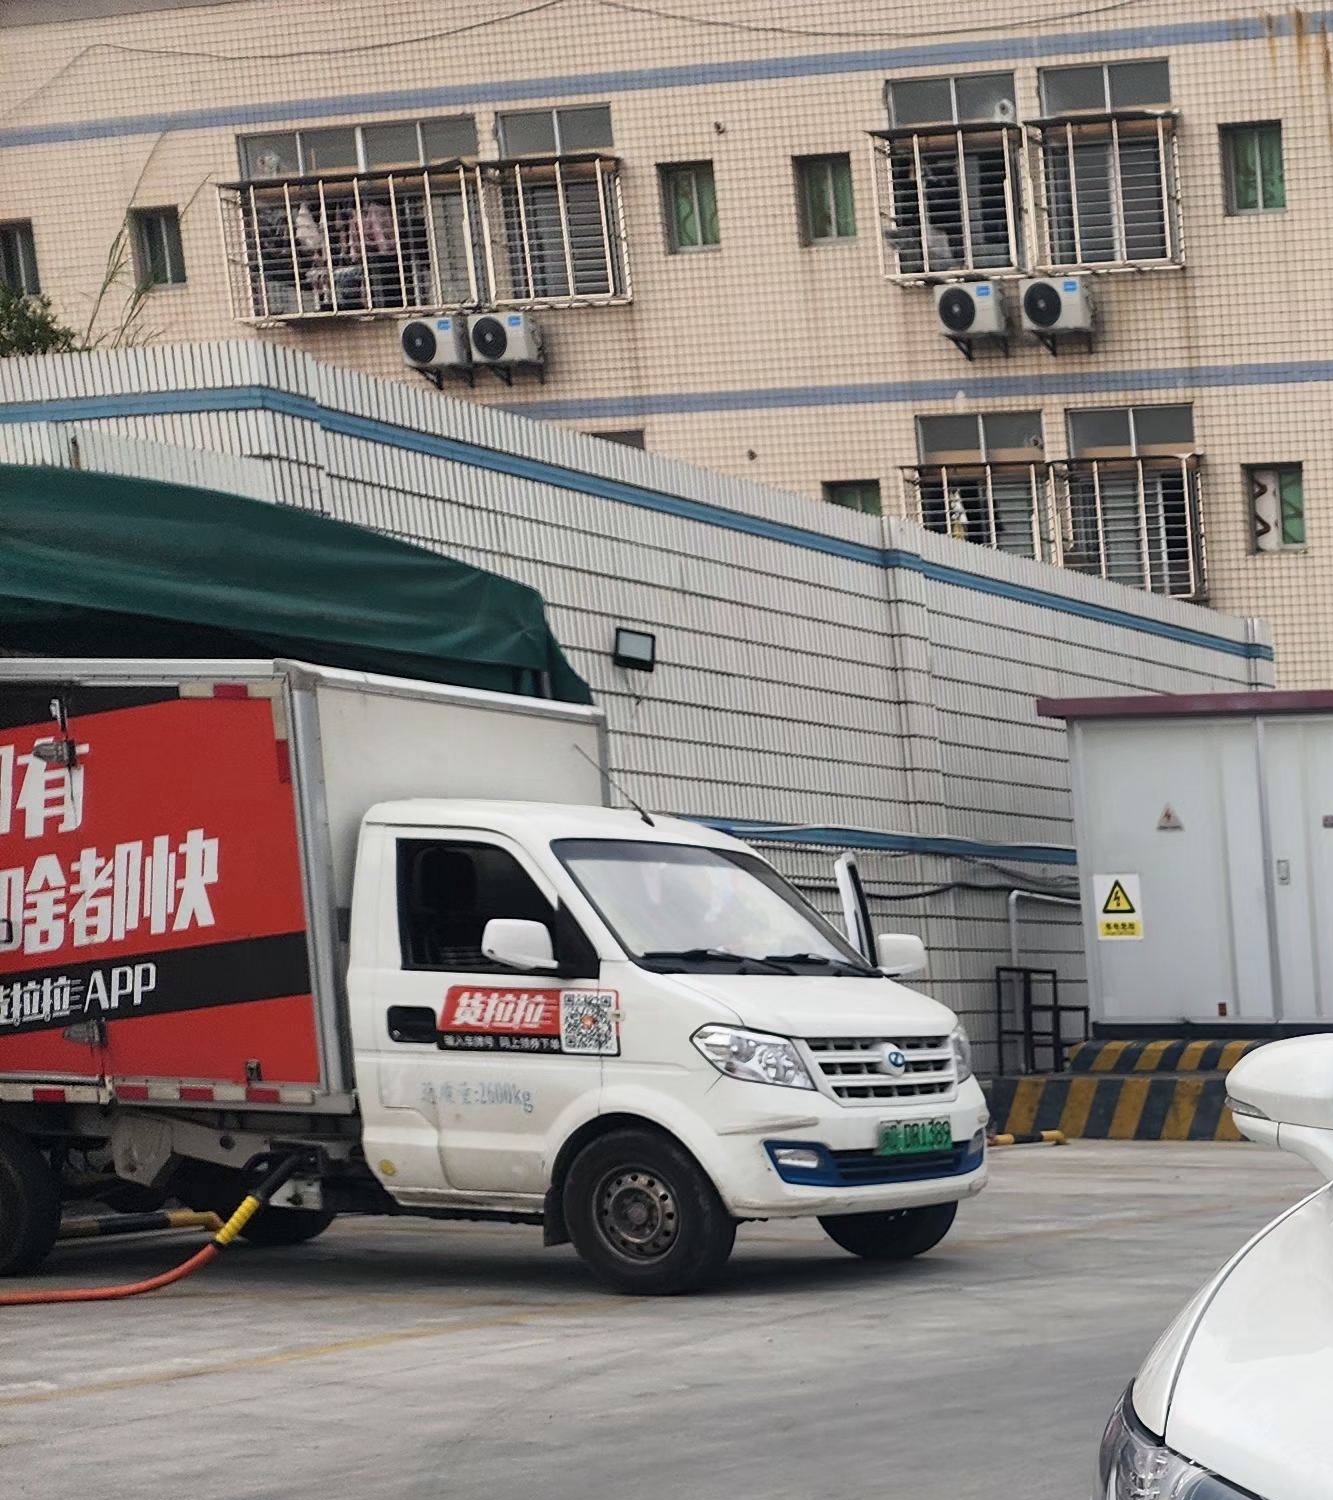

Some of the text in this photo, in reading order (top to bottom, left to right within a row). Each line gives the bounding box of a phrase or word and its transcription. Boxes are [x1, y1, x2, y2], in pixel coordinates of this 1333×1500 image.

[0, 736, 90, 839] 有
[0, 962, 157, 1027] 拉拉APP
[452, 991, 547, 1030] 货拉拉
